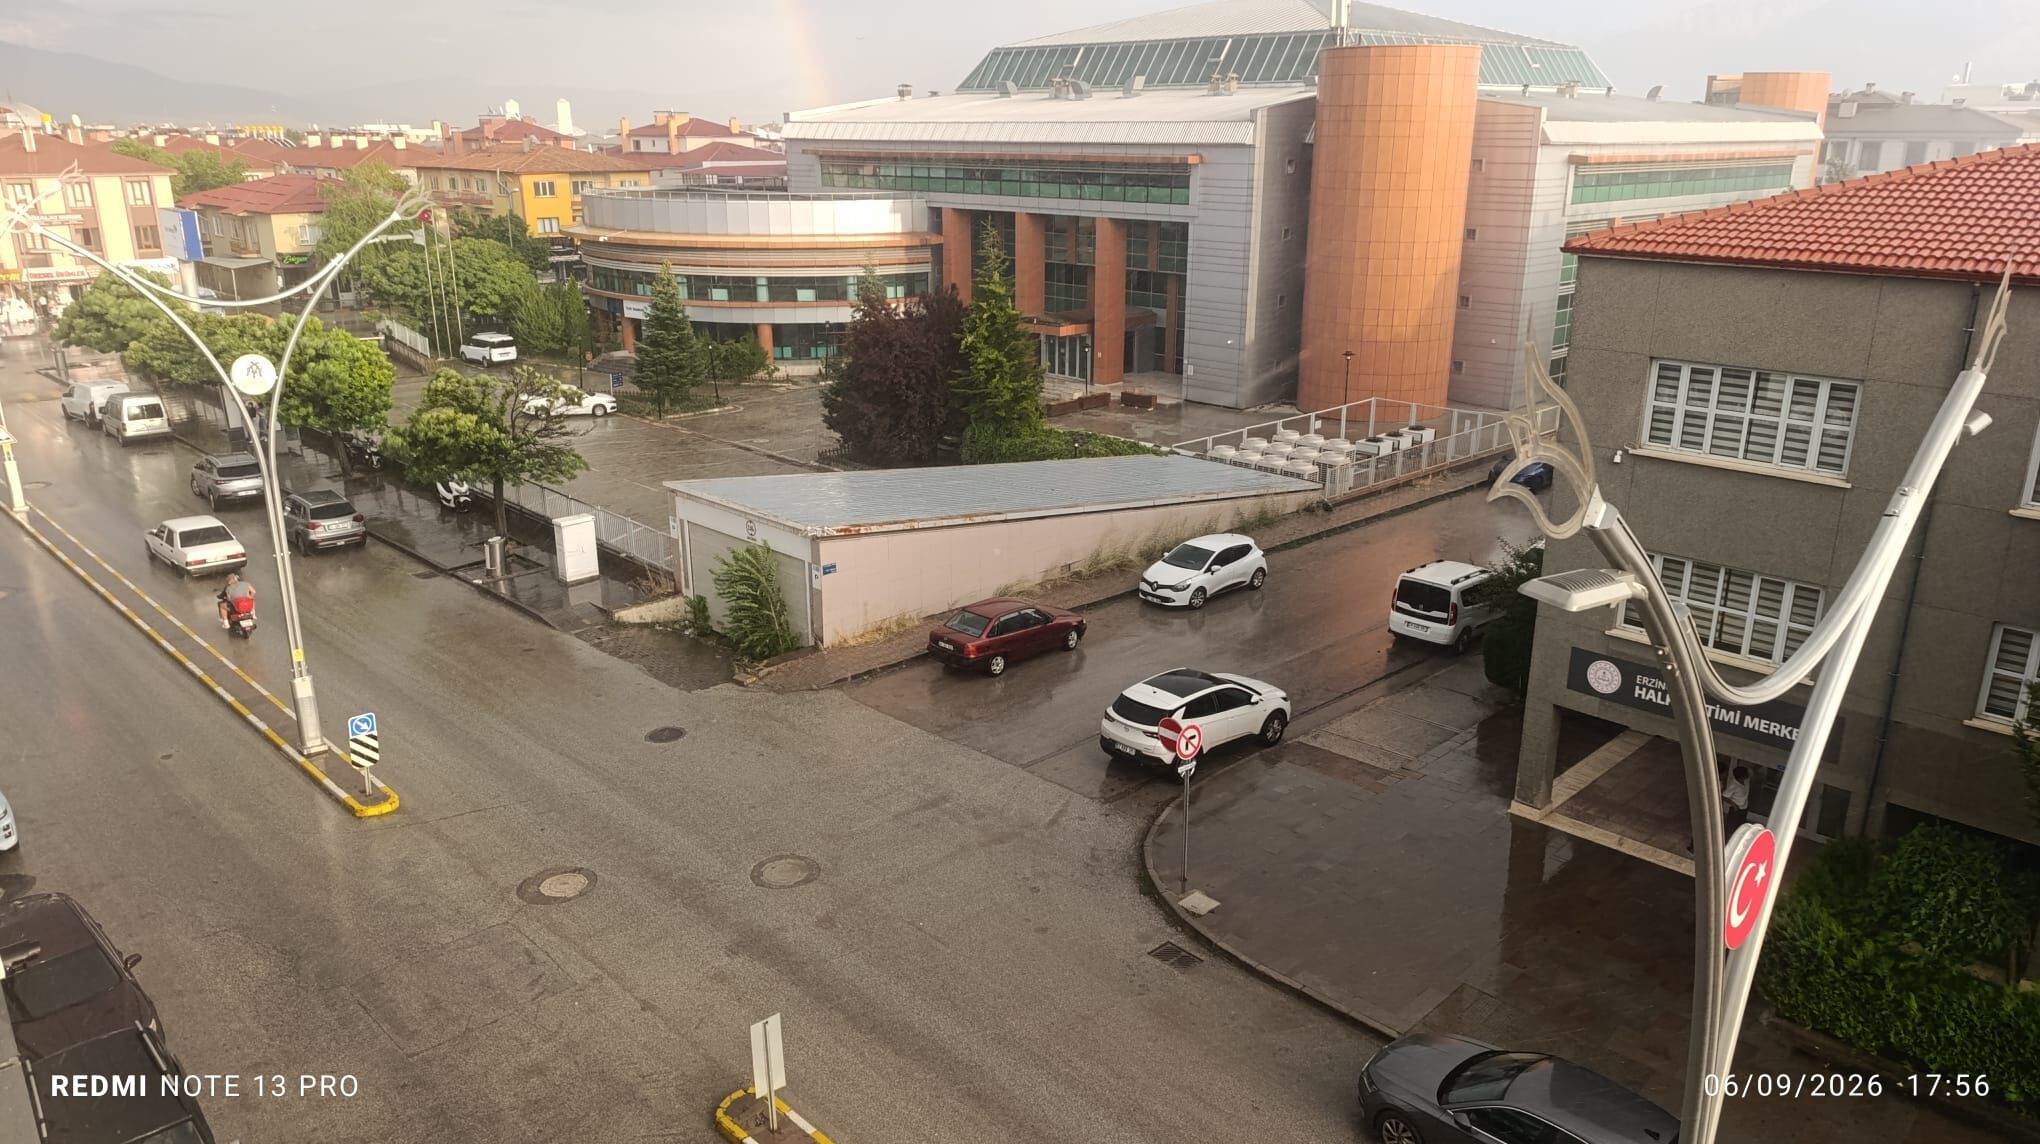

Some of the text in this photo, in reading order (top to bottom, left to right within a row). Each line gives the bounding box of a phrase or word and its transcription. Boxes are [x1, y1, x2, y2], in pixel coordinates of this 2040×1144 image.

[1636, 675, 1667, 691] ERZİN
[1705, 704, 1741, 726] TİMİ
[1743, 715, 1800, 742] MERKE
